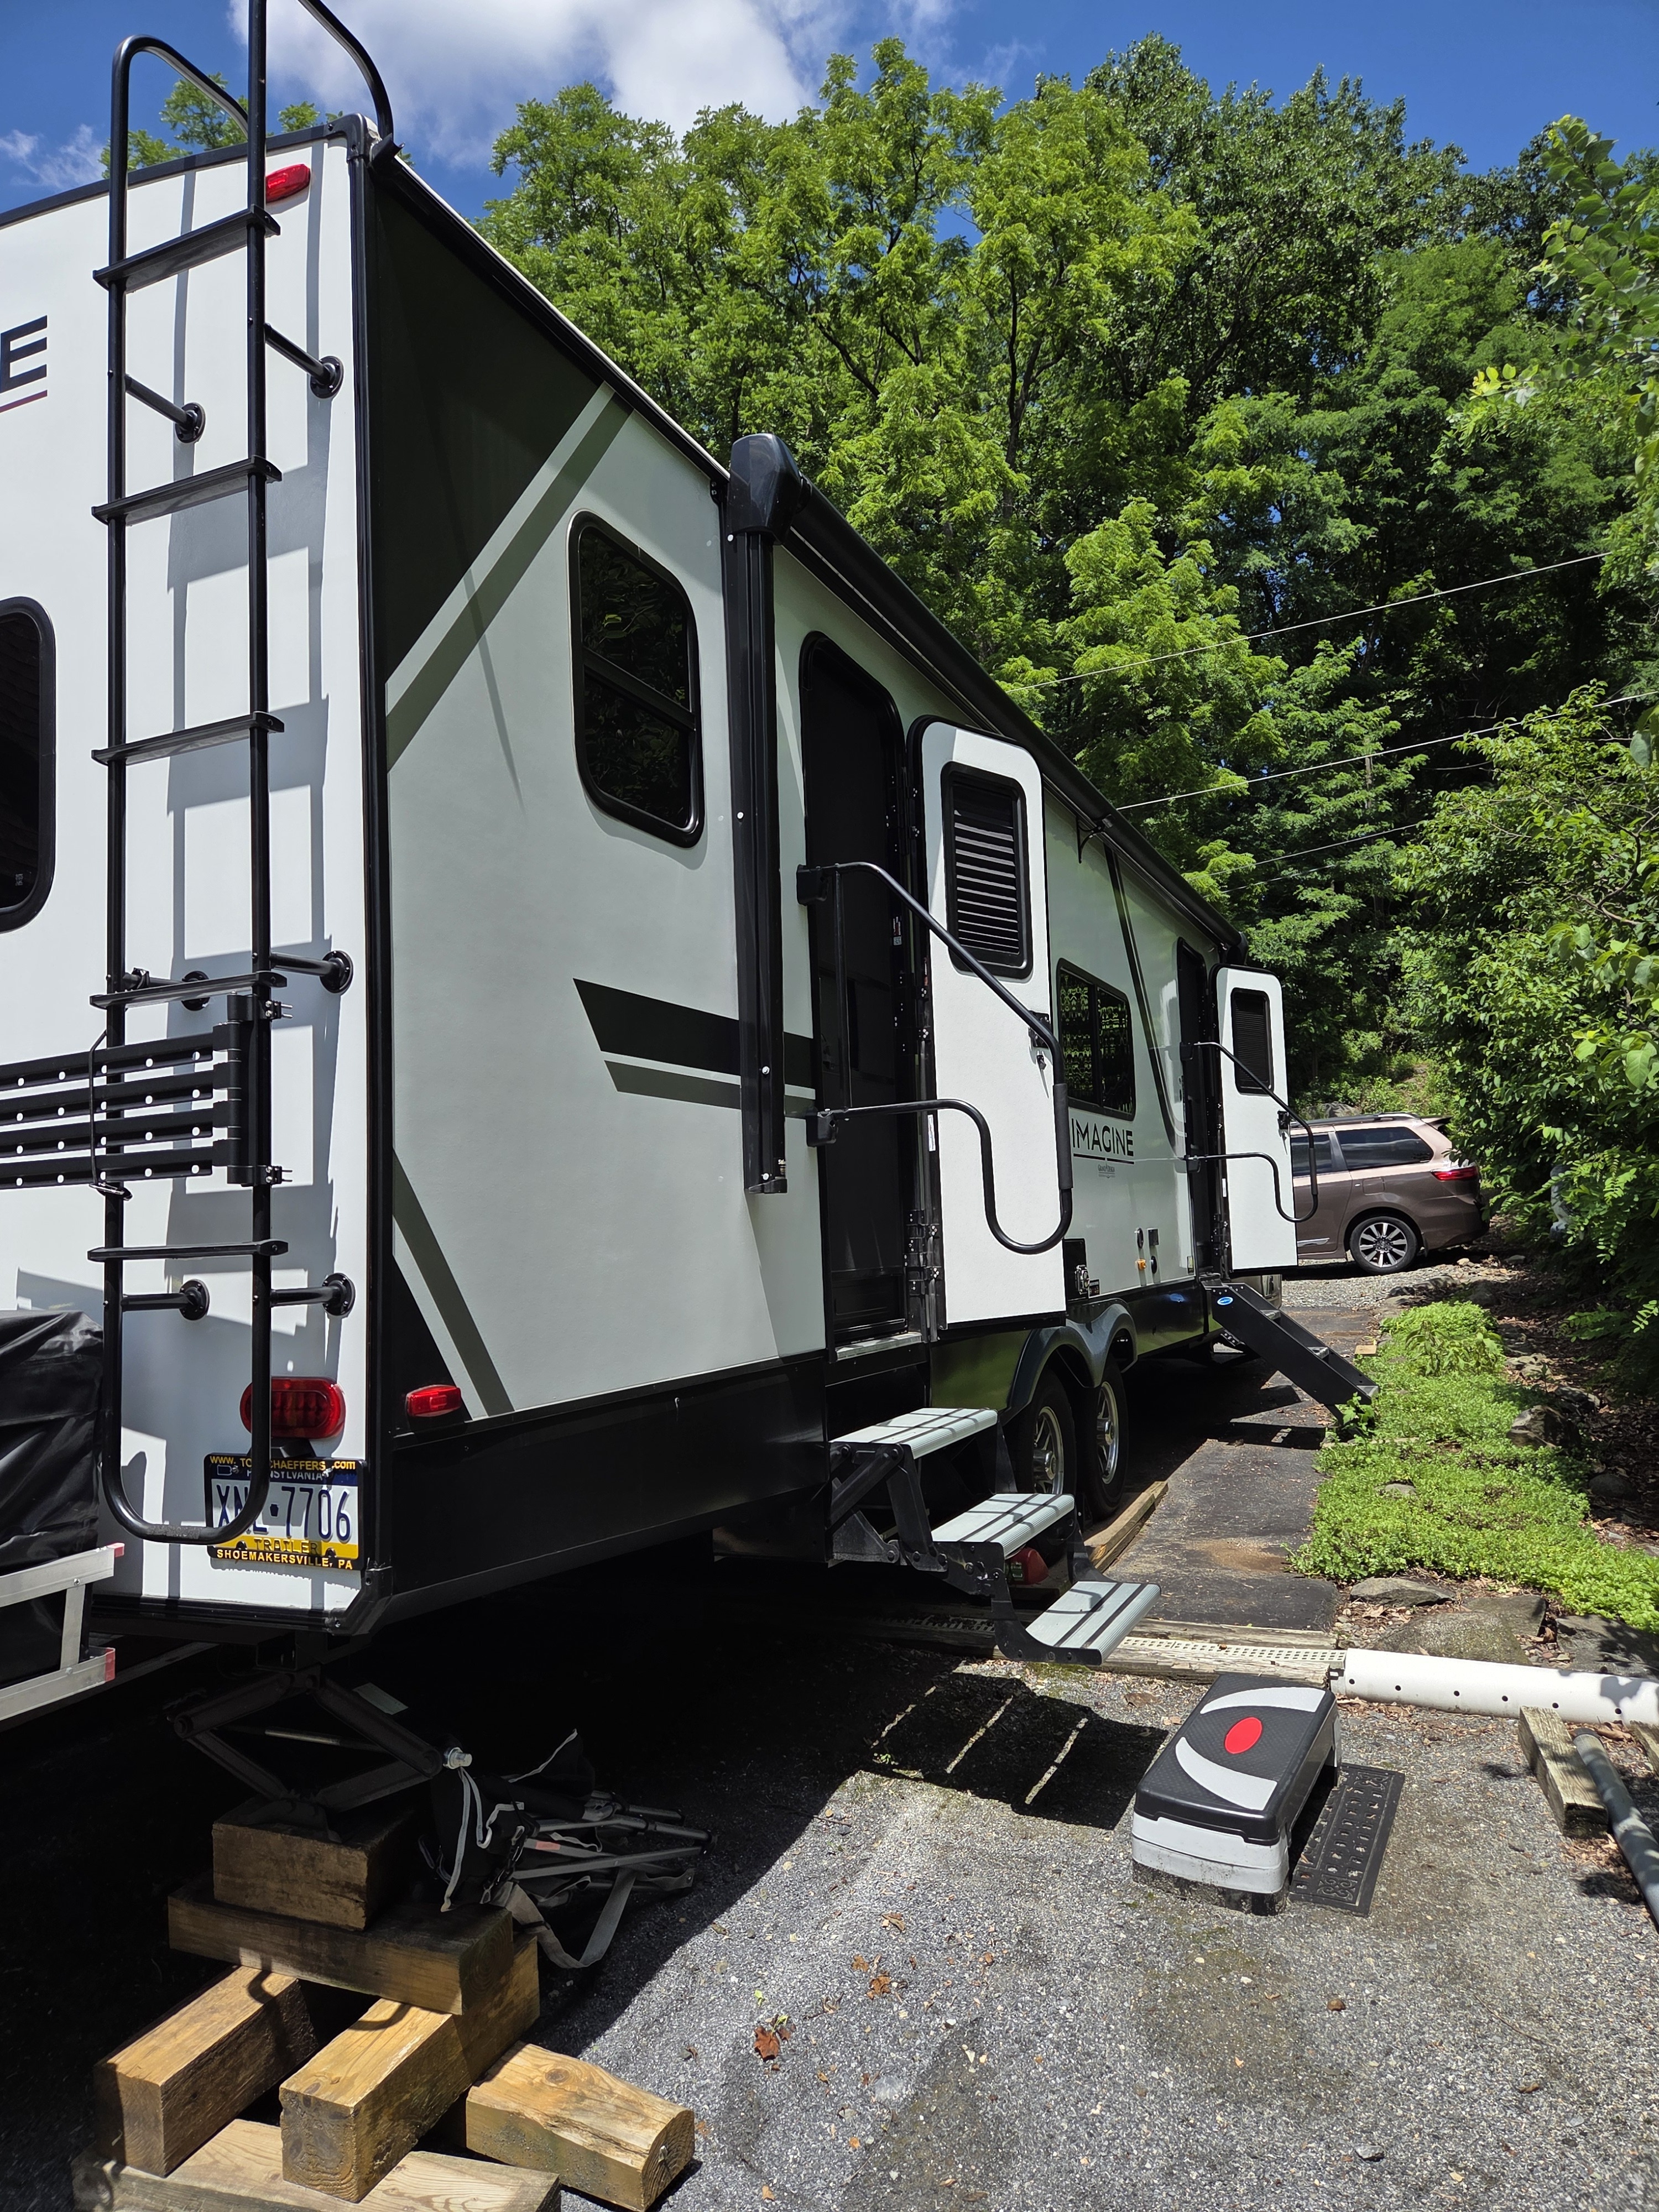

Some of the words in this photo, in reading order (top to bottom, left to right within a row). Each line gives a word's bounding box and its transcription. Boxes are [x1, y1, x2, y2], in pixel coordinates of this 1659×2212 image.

[1072, 1118, 1134, 1157] IMAGINE
[281, 1486, 352, 1543] 7706
[217, 1549, 333, 1568] SHOEMAKERSVILLE,
[338, 1559, 353, 1570] PA
[253, 1537, 319, 1556] TRAILER
